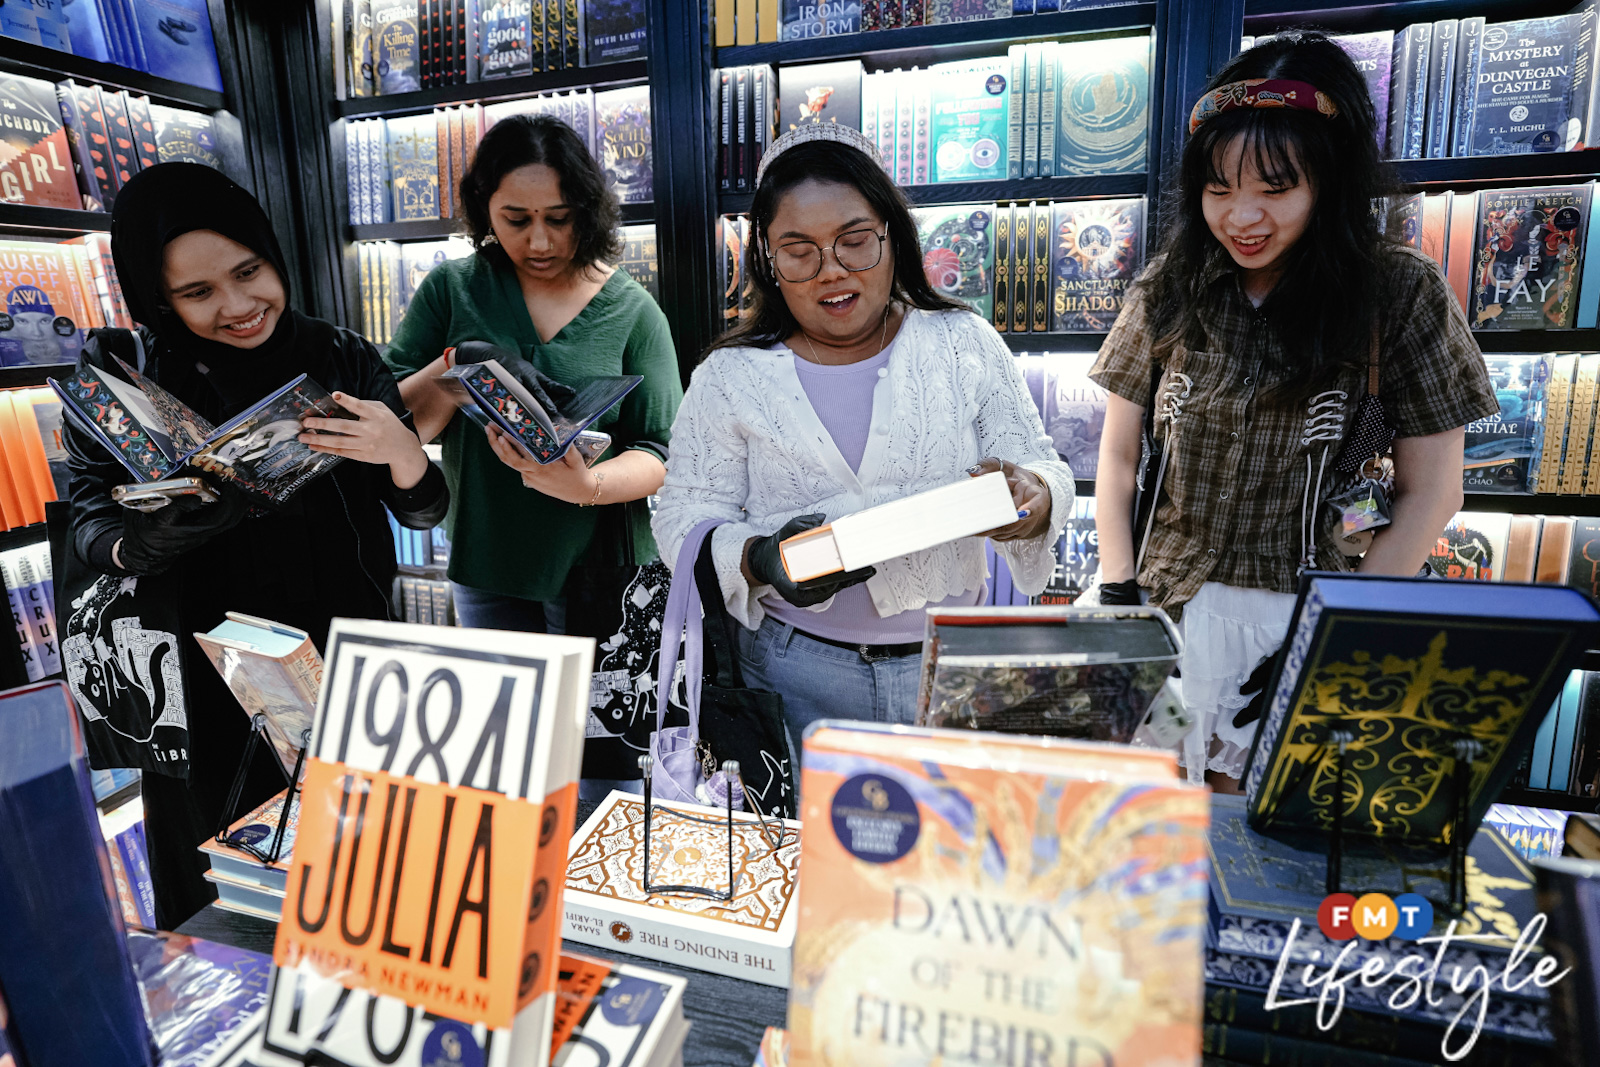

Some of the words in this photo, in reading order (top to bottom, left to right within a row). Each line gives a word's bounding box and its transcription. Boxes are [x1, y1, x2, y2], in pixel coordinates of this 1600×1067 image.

[482, 7, 498, 23] of
[502, 1, 530, 19] the
[799, 2, 844, 21] IRON
[488, 21, 525, 49] good
[791, 18, 853, 39] STORM
[384, 31, 415, 47] Killing
[594, 36, 617, 46] BETH
[619, 31, 647, 41] LEWIS
[387, 46, 411, 59] Time
[489, 48, 528, 70] guys
[1488, 45, 1564, 63] MYSTERY
[1479, 65, 1568, 84] DUNVEGAN
[1492, 80, 1551, 95] CASTLE
[173, 128, 192, 139] THE
[1510, 124, 1545, 132] HUCHU
[607, 142, 646, 160] WIND
[1009, 126, 1022, 161] COUNTRY
[1024, 125, 1038, 161] COUNTRY
[1041, 124, 1054, 160] COUNTRY
[1, 142, 66, 202] GIRL
[1487, 199, 1529, 208] SOPHIE
[1537, 197, 1582, 206] KEETCH
[1516, 255, 1539, 272] LE
[1061, 279, 1128, 291] SANCTUARY
[1494, 278, 1556, 304] FAY
[0, 290, 67, 305] RAWLER
[1464, 423, 1518, 434] ESTIAL
[1066, 545, 1093, 570] by
[1050, 564, 1096, 588] Five
[1041, 596, 1070, 605] CLAIRE
[29, 587, 56, 656] CRUX
[301, 651, 320, 671] MY
[337, 655, 517, 797] 1984
[295, 774, 495, 979] JULIA
[566, 911, 603, 927] EL-ARIFI
[893, 884, 1083, 960] DAWN
[571, 922, 601, 936] SAARA
[639, 930, 669, 948] FIRE
[674, 938, 739, 964] ENDING
[744, 954, 776, 972] THE
[284, 938, 370, 981] SANDRA
[379, 964, 491, 1014] NEWMAN
[912, 954, 960, 991] OF
[978, 966, 1058, 1014] THE
[853, 993, 1115, 1067] FIREBIRD
